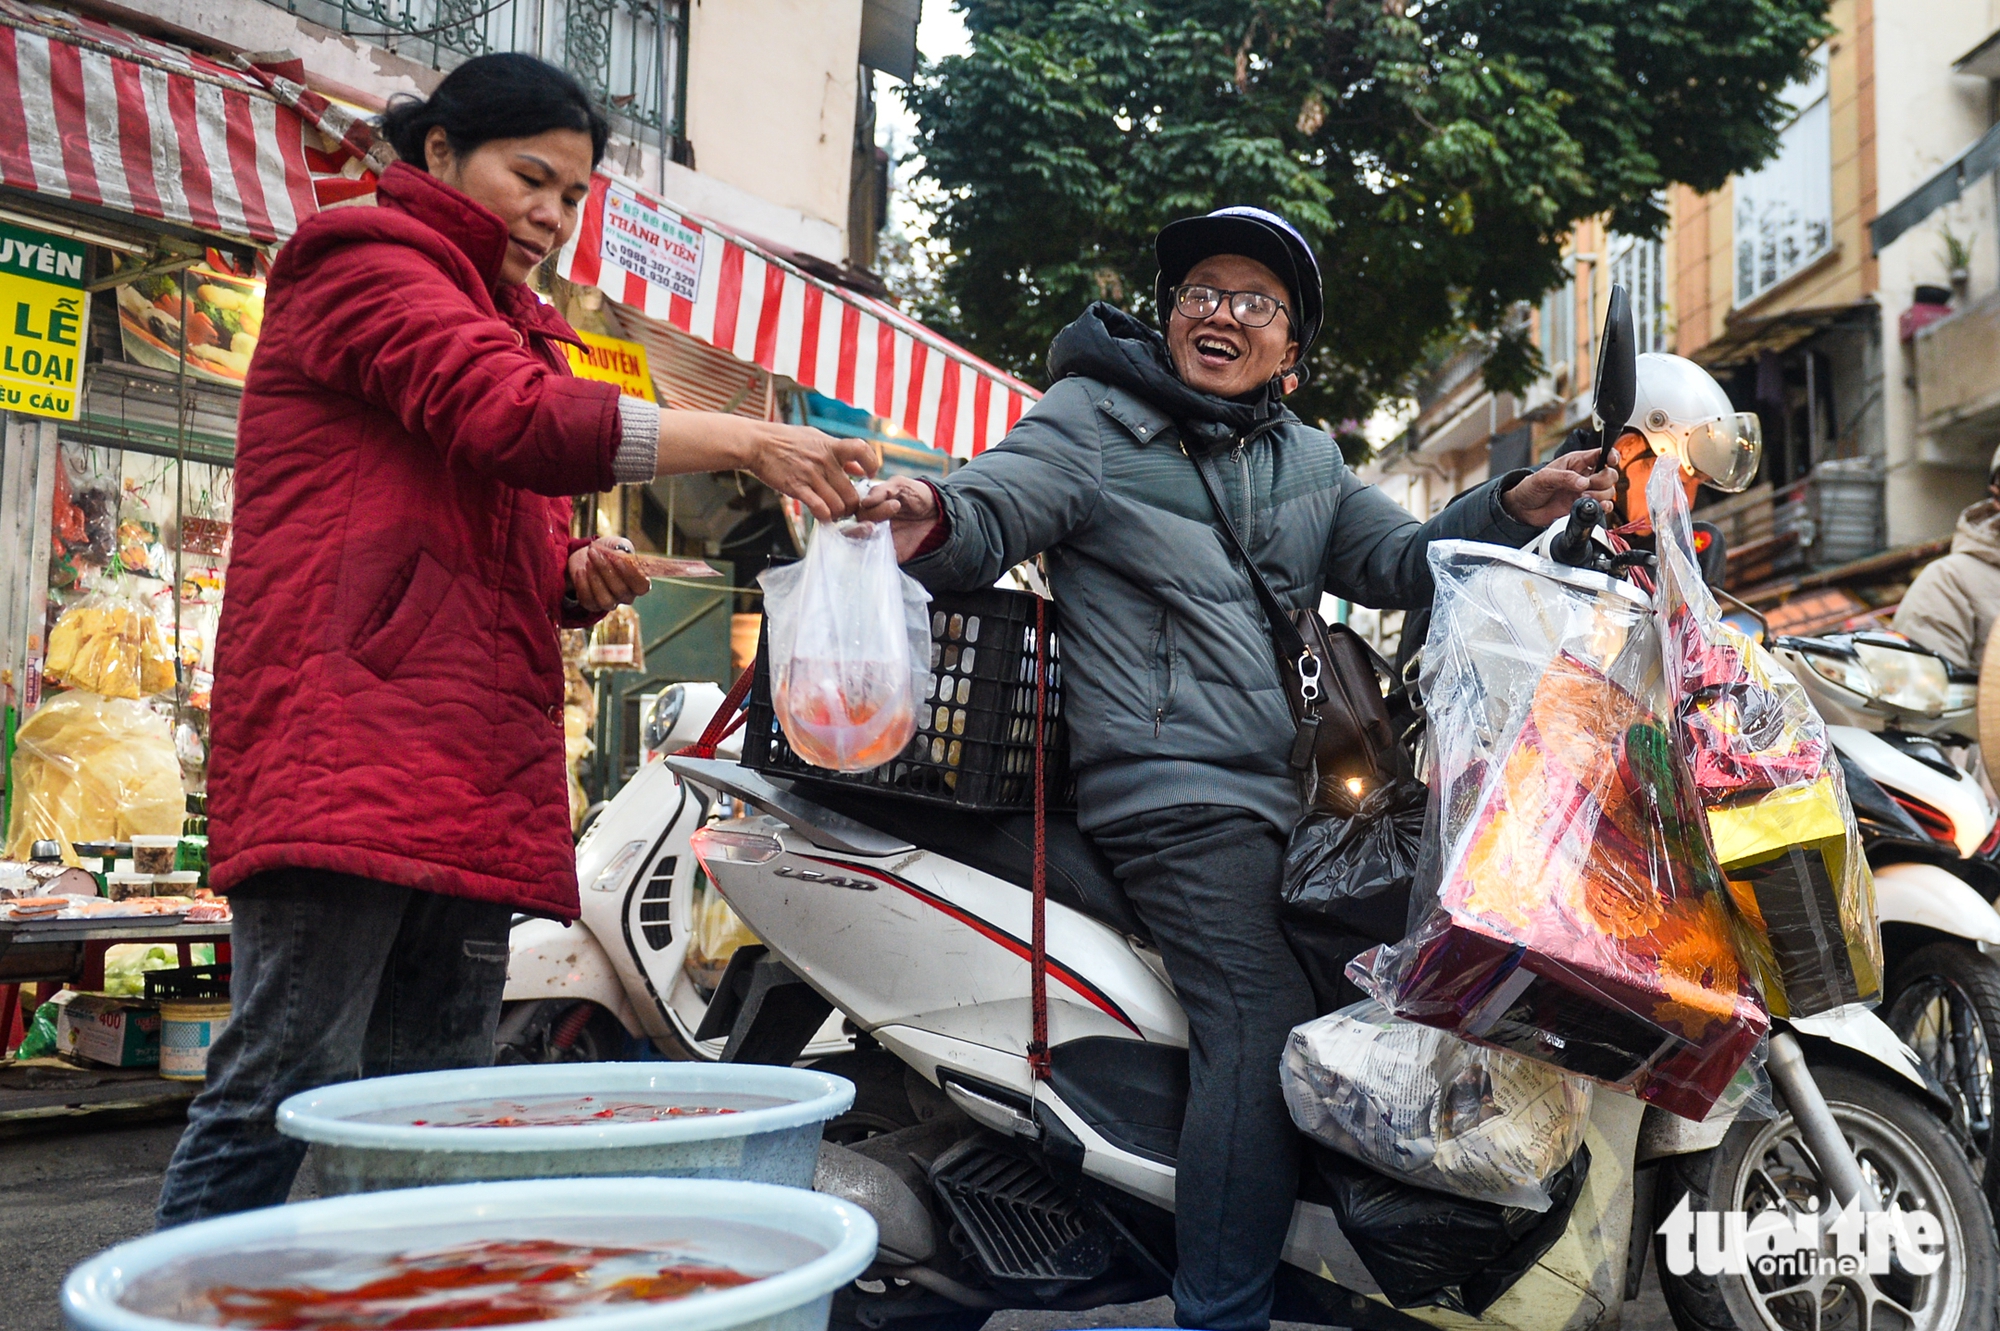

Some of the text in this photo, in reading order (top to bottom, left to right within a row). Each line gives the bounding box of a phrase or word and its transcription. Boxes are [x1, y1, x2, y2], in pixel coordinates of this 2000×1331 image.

[14, 298, 79, 347] LỄ
[4, 345, 74, 385] LOẠI
[773, 866, 879, 892] LEAD
[99, 1012, 121, 1030] 400
